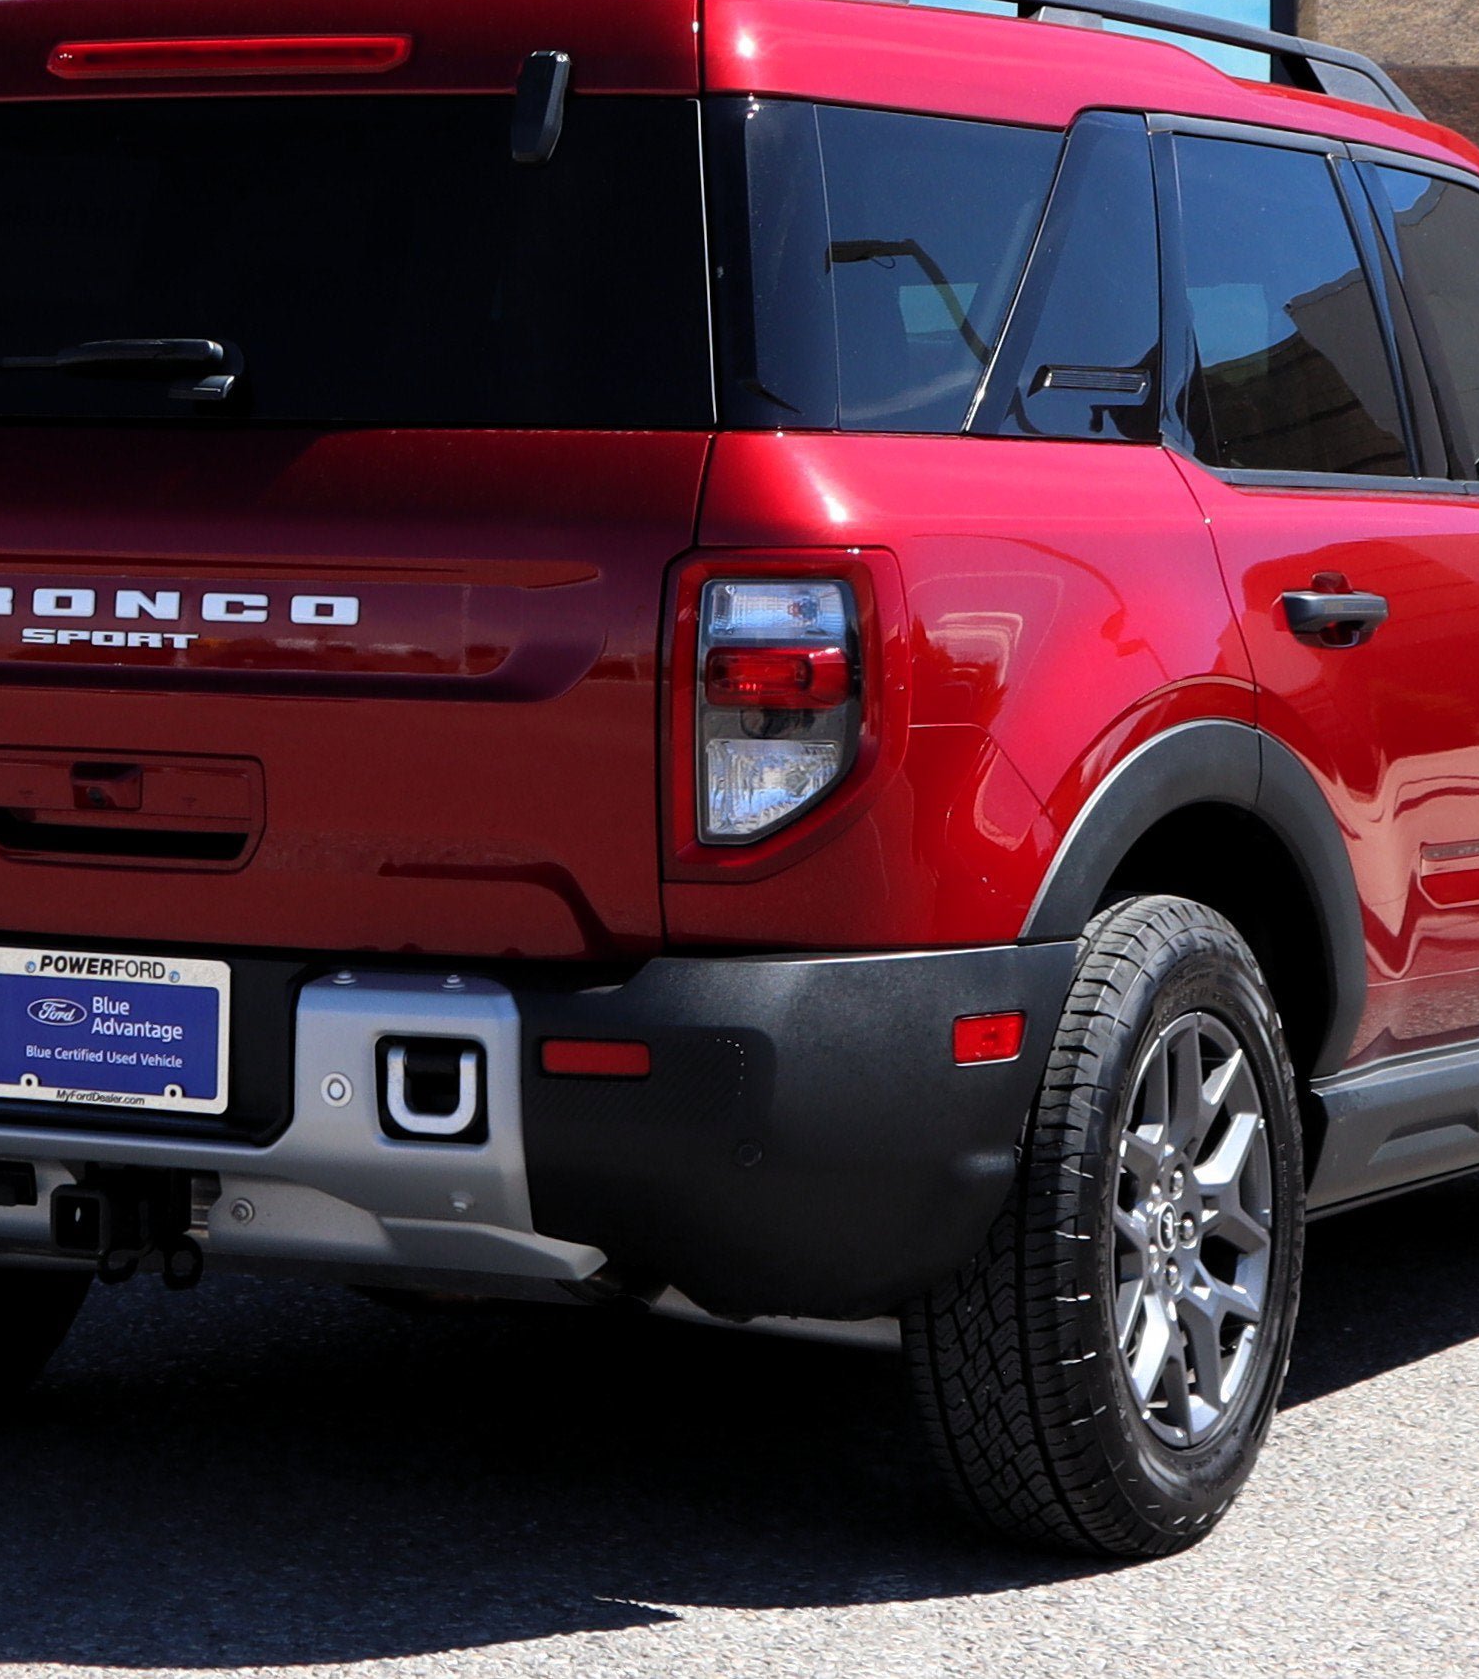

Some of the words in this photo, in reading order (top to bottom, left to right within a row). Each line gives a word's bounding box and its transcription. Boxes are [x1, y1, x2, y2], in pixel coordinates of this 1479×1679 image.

[20, 627, 199, 650] SPORT
[39, 955, 166, 979] POWERFORD
[38, 1002, 76, 1022] Ford
[92, 996, 130, 1015] Blue
[91, 1017, 184, 1042] Advantage
[26, 1045, 51, 1059] Blue
[54, 1047, 103, 1064] Certified
[106, 1050, 137, 1066] Used
[139, 1052, 183, 1068] Vehicle
